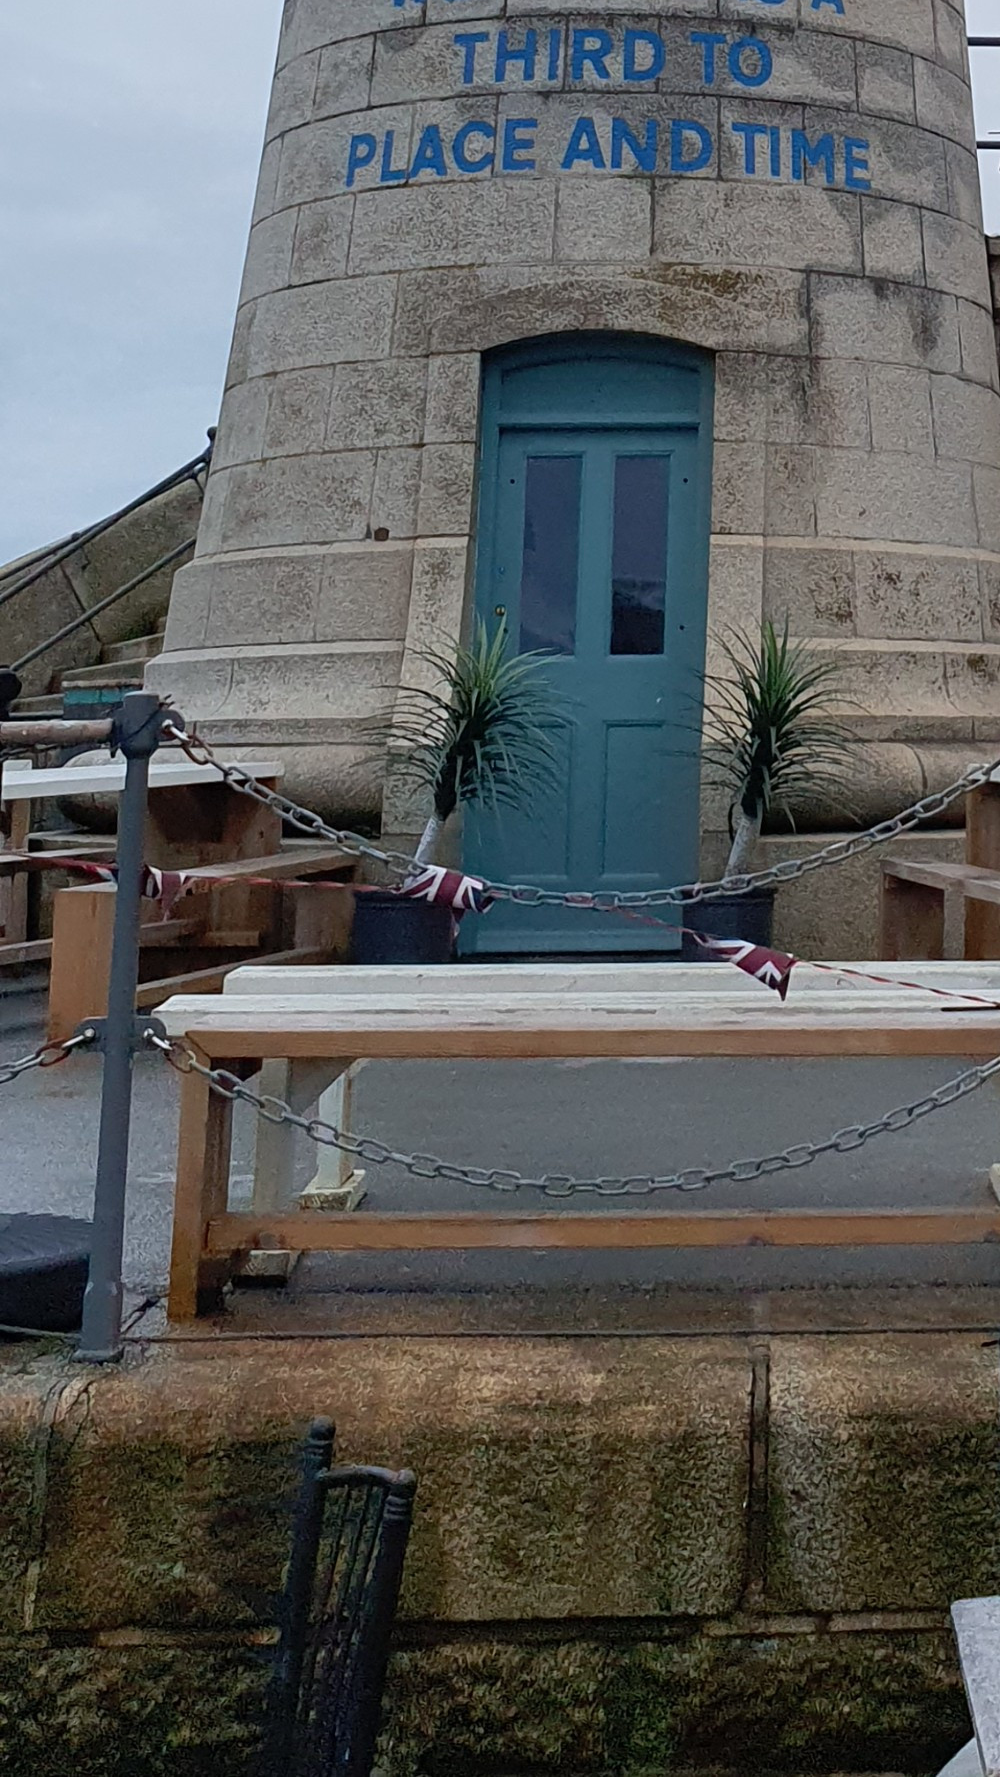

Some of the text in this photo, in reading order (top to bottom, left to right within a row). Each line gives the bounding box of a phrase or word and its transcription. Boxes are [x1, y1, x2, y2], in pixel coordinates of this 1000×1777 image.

[453, 28, 773, 88] THIRD TO
[345, 117, 873, 191] PLACE AND TIME
